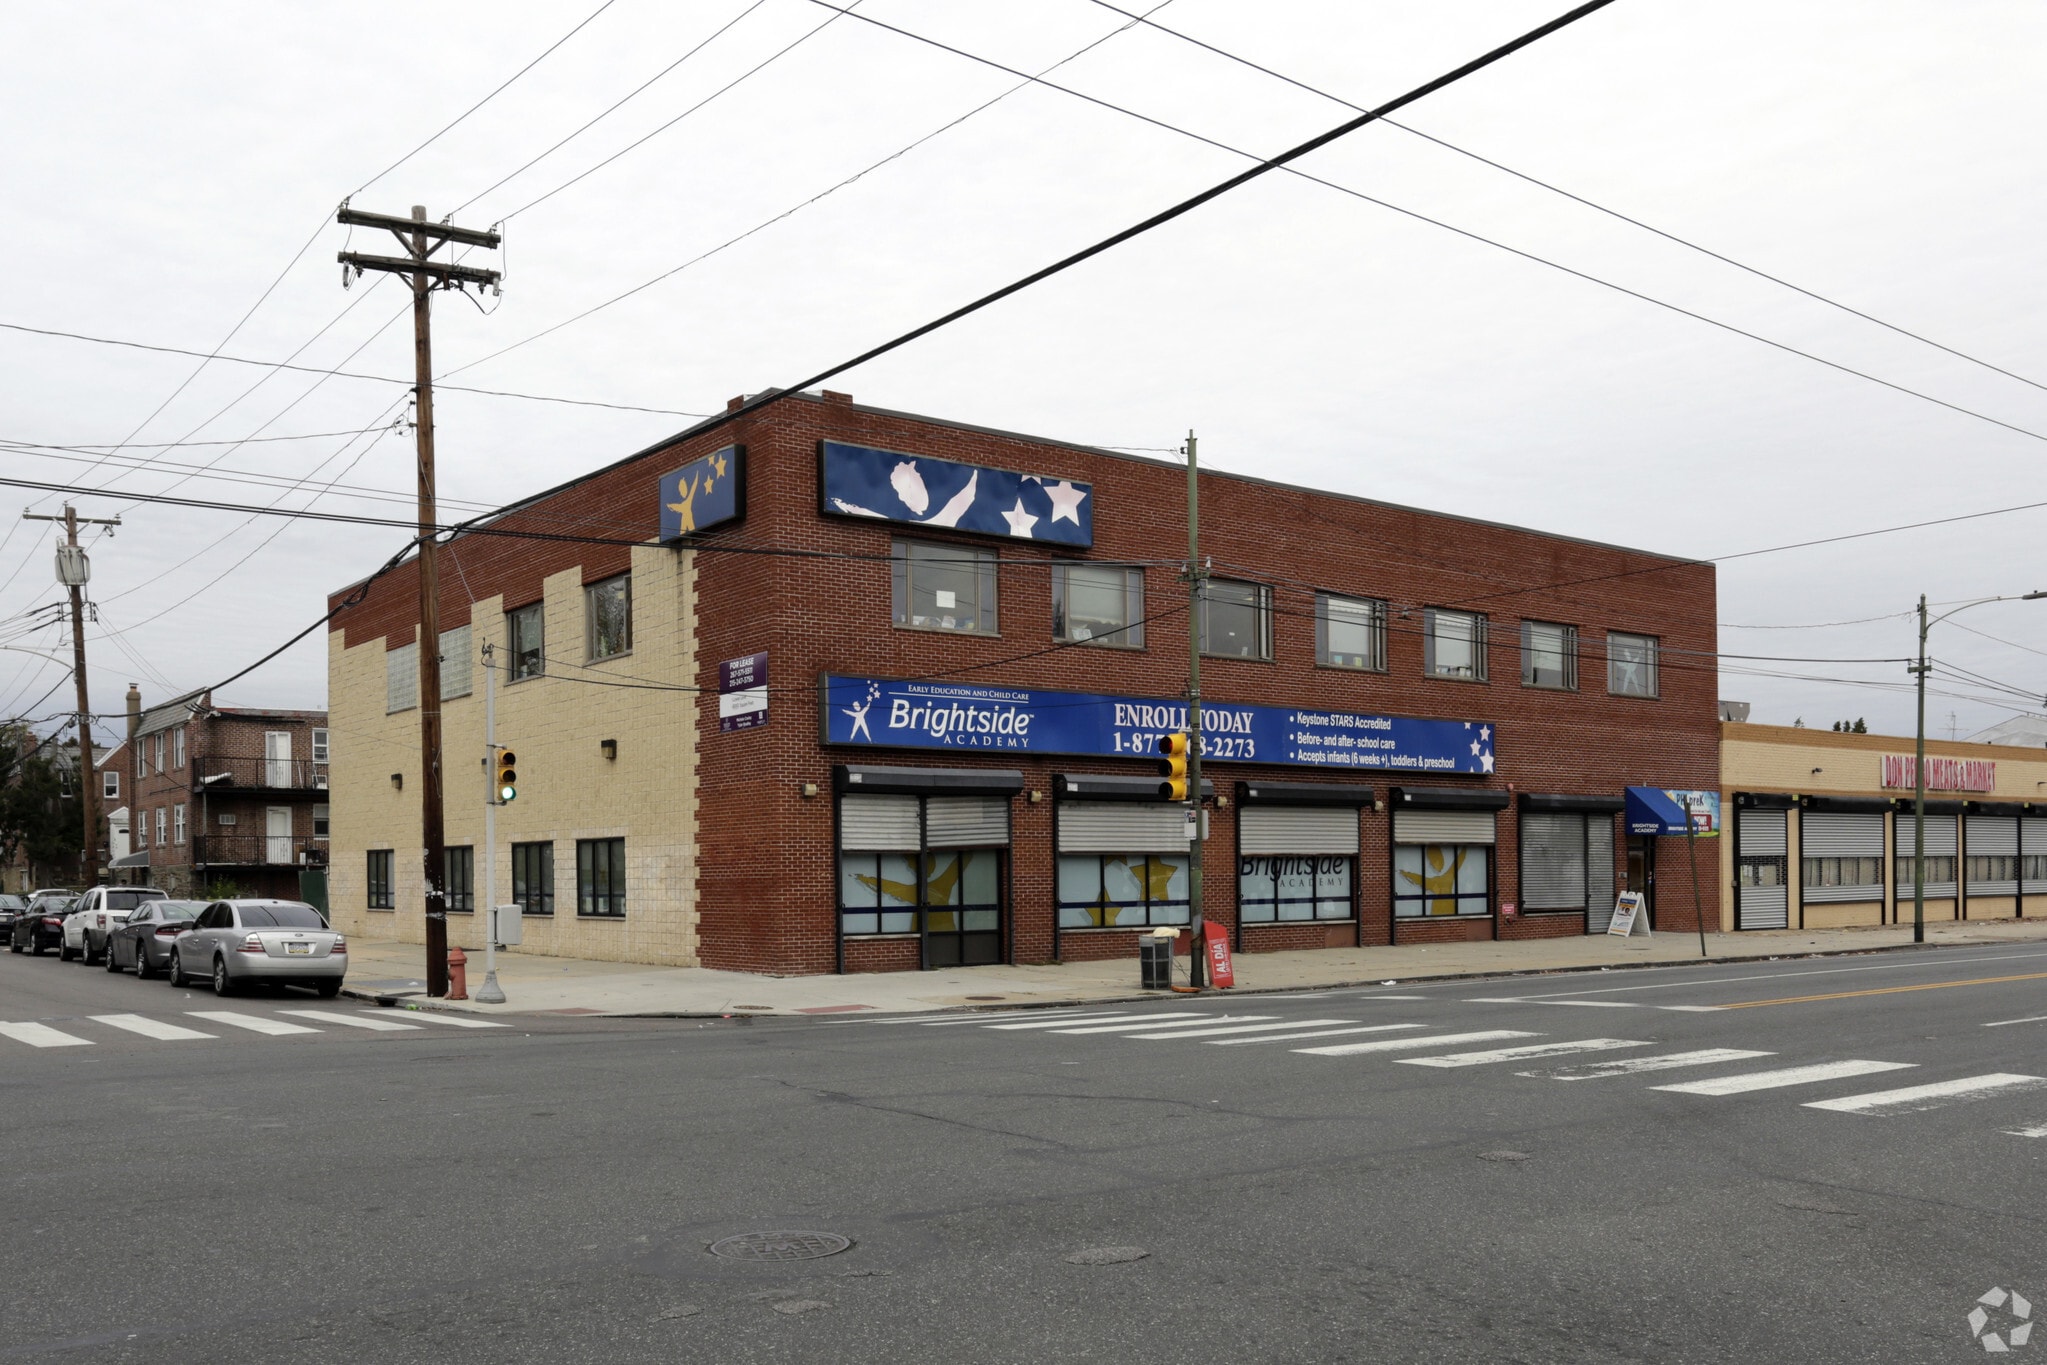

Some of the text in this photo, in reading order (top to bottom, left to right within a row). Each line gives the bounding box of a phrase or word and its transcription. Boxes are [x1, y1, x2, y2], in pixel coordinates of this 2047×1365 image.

[908, 685, 929, 693] EARLY
[931, 686, 971, 696] EDUCATION
[989, 690, 1011, 699] CHILD
[1012, 692, 1029, 700] CARE
[888, 699, 1030, 738] Brightside
[1114, 703, 1191, 730] ENROLL
[1297, 711, 1391, 730] Keystone STARS Accredited
[944, 735, 1029, 747] ACADEMY
[1297, 732, 1322, 745] Before-
[1323, 734, 1337, 746] and
[1357, 736, 1379, 748] school
[1380, 739, 1396, 749] care
[1298, 749, 1326, 764] Accepts
[1327, 751, 1350, 763] infants
[1359, 753, 1380, 765] weeks
[1391, 754, 1417, 767] toddlers
[1418, 755, 1424, 767] &
[1424, 756, 1455, 770] preschool
[1885, 755, 1903, 787] DON
[1905, 757, 1931, 789] PEO
[1932, 758, 1959, 789] MEATS
[1966, 760, 1996, 791] MARKET
[1216, 961, 1226, 973] AL
